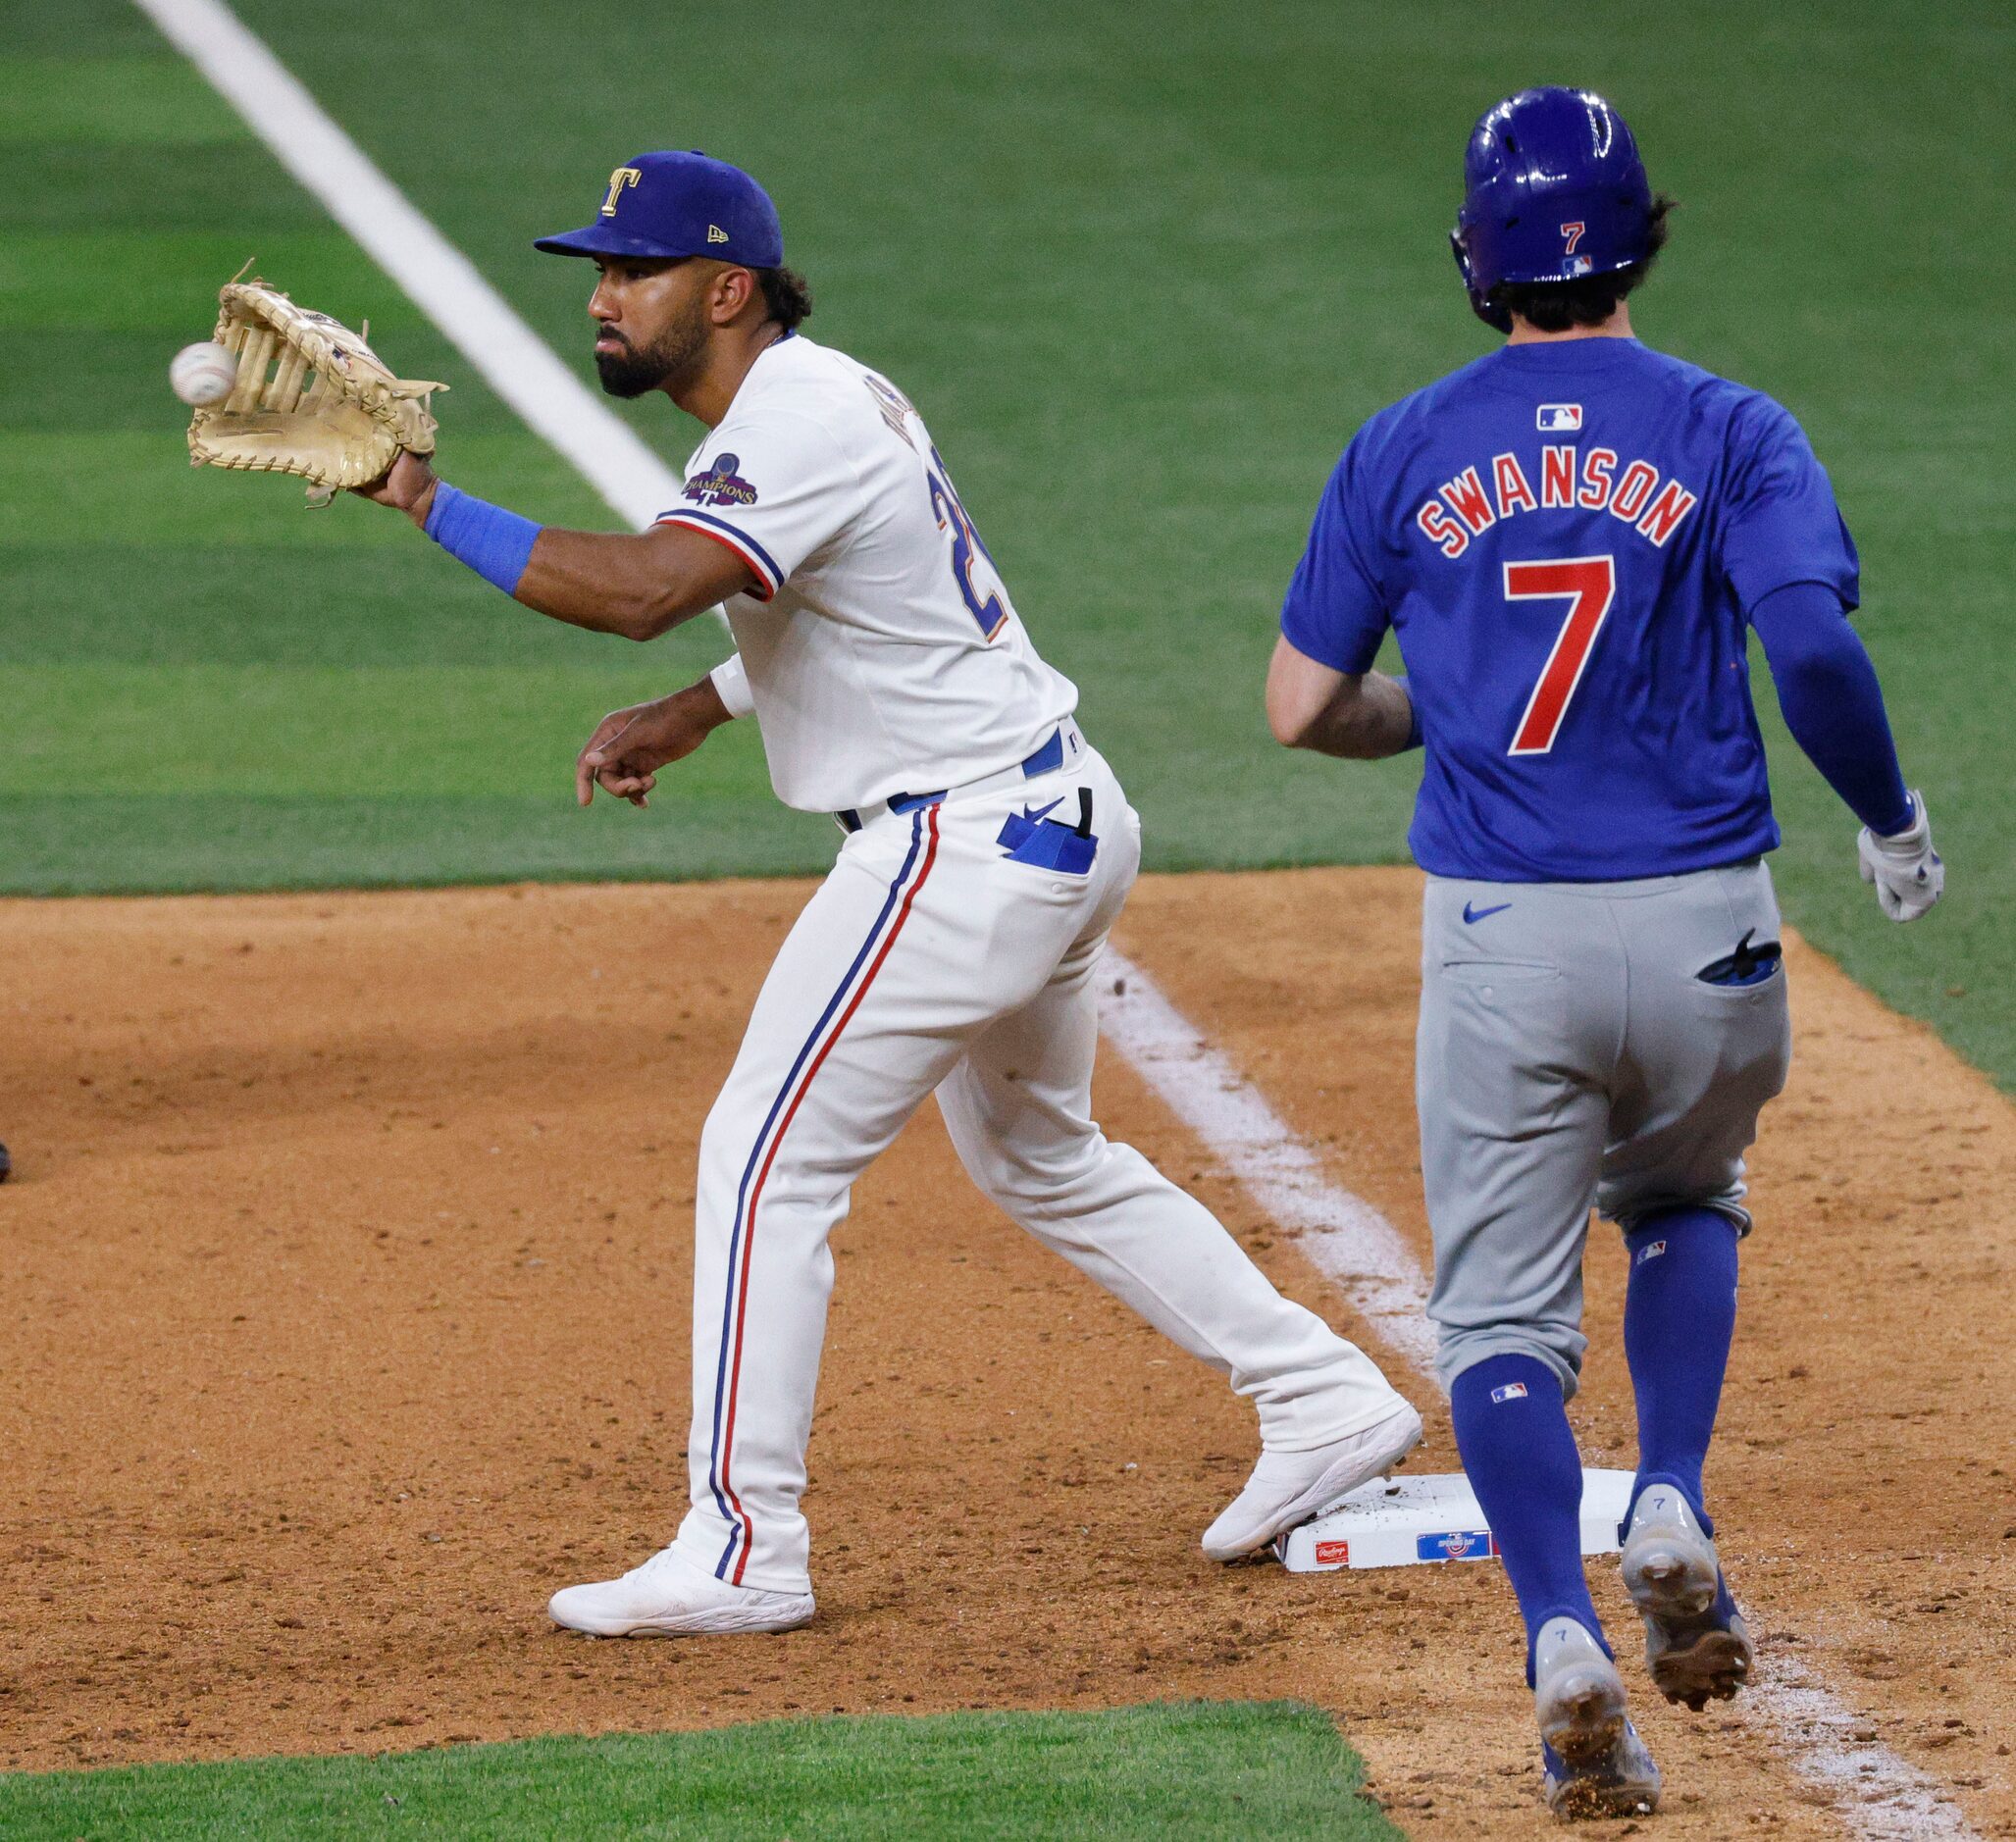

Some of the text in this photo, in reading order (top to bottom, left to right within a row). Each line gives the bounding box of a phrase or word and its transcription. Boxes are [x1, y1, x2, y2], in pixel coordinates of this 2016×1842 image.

[601, 167, 643, 218] T
[1560, 221, 1585, 255] 7
[687, 478, 755, 505] CHAMPIONS
[1418, 445, 1698, 559] SWANSON
[1503, 554, 1617, 756] 7
[1653, 1497, 1667, 1510] 7
[1555, 1629, 1568, 1642] 7
